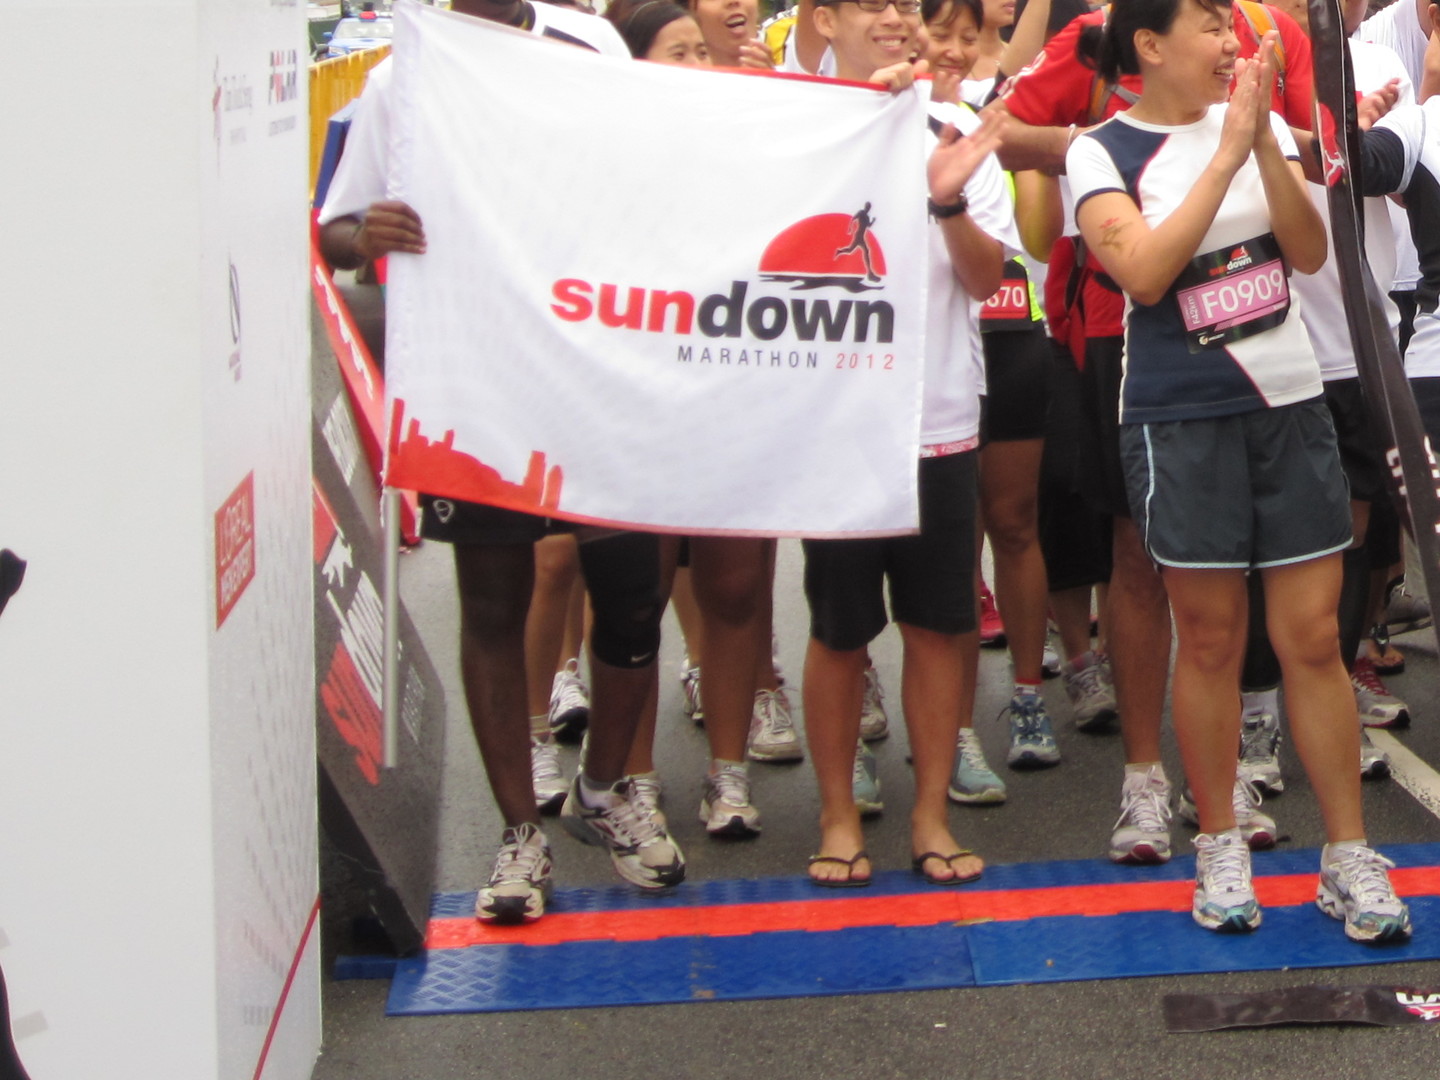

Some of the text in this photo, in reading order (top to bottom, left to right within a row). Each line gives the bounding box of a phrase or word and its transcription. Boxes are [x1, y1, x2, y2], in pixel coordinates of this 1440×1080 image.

[550, 278, 896, 344] sundown
[1201, 268, 1284, 319] F0909
[677, 345, 894, 370] MARATHON 2012
